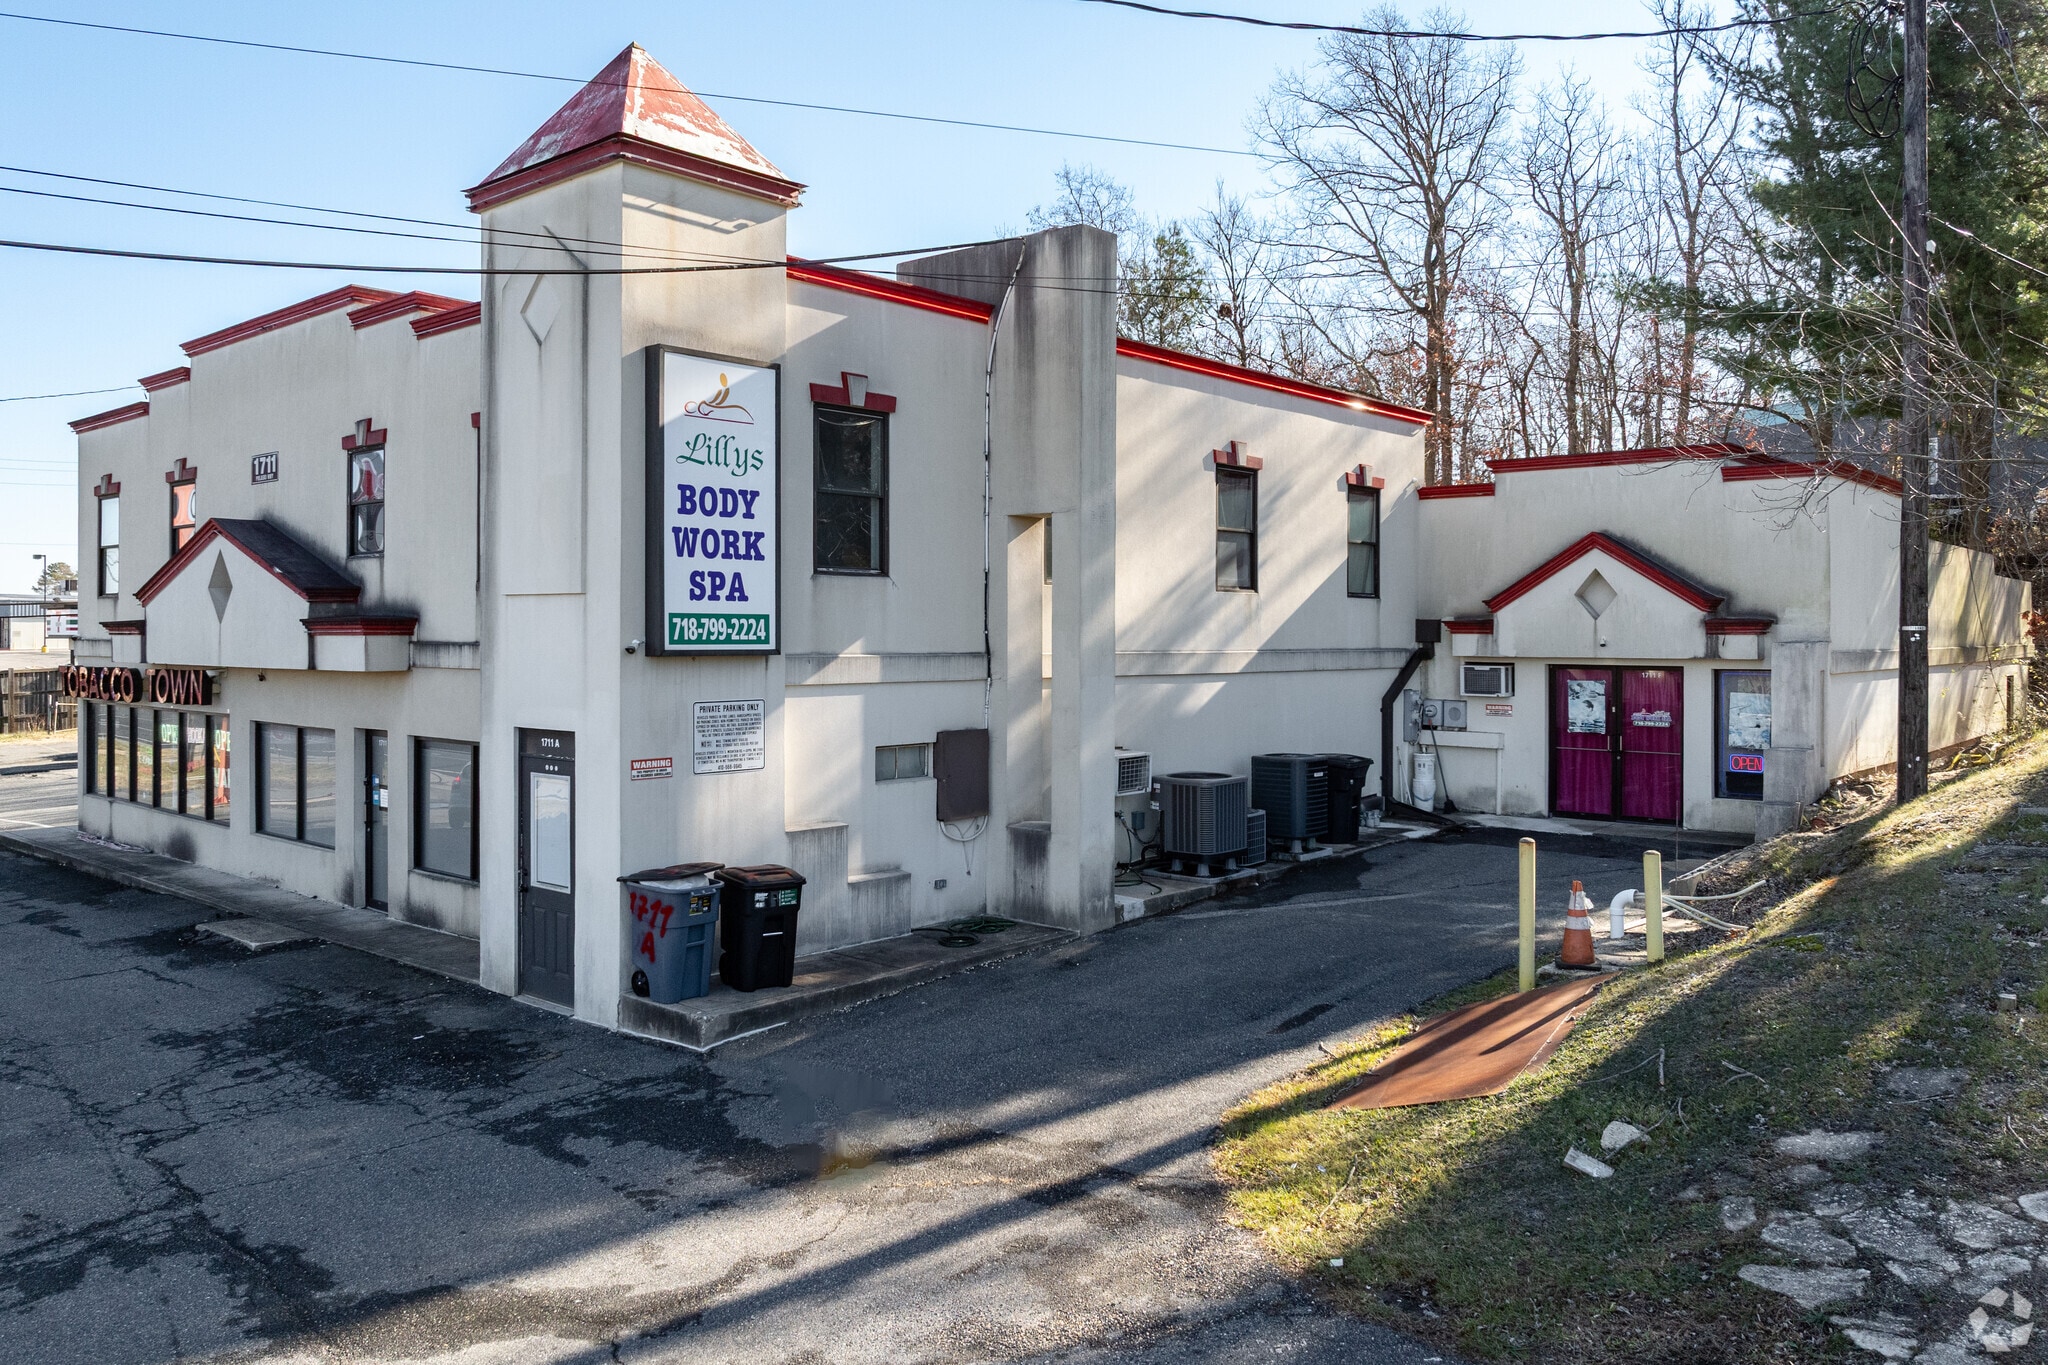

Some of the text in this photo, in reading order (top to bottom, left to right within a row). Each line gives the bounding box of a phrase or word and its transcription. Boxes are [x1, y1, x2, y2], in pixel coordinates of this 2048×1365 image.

[254, 455, 276, 475] 1711
[676, 433, 764, 477] Lillys
[677, 484, 760, 519] BODY
[672, 526, 765, 561] WORK
[689, 570, 749, 602] SPA
[672, 617, 766, 641] 718-799-2224
[58, 665, 204, 705] TOBACCO TOWN
[699, 703, 760, 714] PRIVATE PARKING ONLY
[541, 738, 560, 748] 1711 A
[632, 759, 671, 769] WARNING
[1731, 756, 1763, 770] OPEN
[641, 930, 656, 964] A
